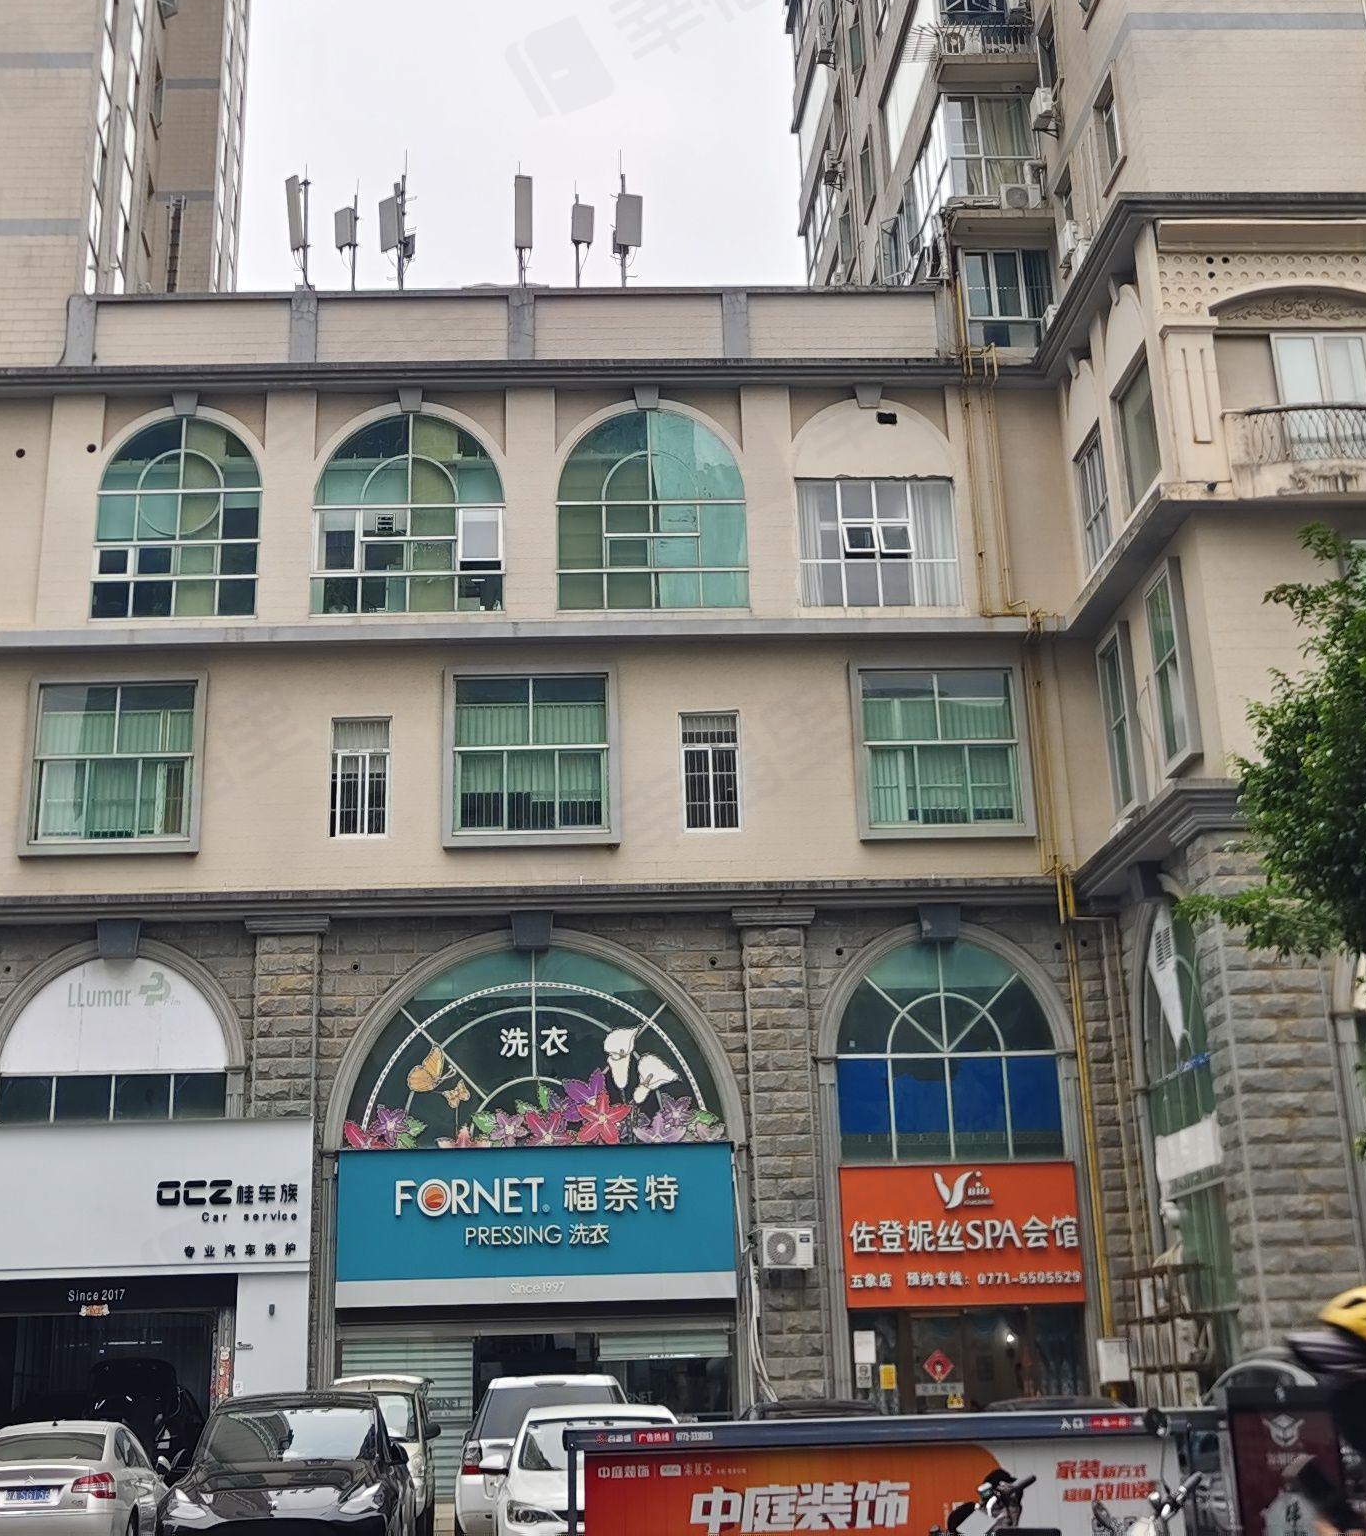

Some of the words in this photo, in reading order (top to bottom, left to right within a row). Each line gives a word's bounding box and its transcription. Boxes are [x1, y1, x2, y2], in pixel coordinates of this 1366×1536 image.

[500, 1026, 569, 1057] 洗衣
[236, 1183, 298, 1204] 桂车族
[395, 1177, 546, 1217] FORNET
[563, 1175, 679, 1212] 福奈特
[201, 1212, 227, 1222] Car
[243, 1211, 298, 1221] service
[465, 1225, 562, 1245] PRESSING
[568, 1223, 610, 1245] 洗衣
[850, 1215, 1079, 1253] 佐登妮丝SPA会馆
[184, 1242, 296, 1258] 专业汽车洗护
[850, 1273, 892, 1289] 五象店
[68, 1290, 99, 1302] Since
[102, 1289, 125, 1302] 2017
[690, 1480, 910, 1534] 中庭装饰
